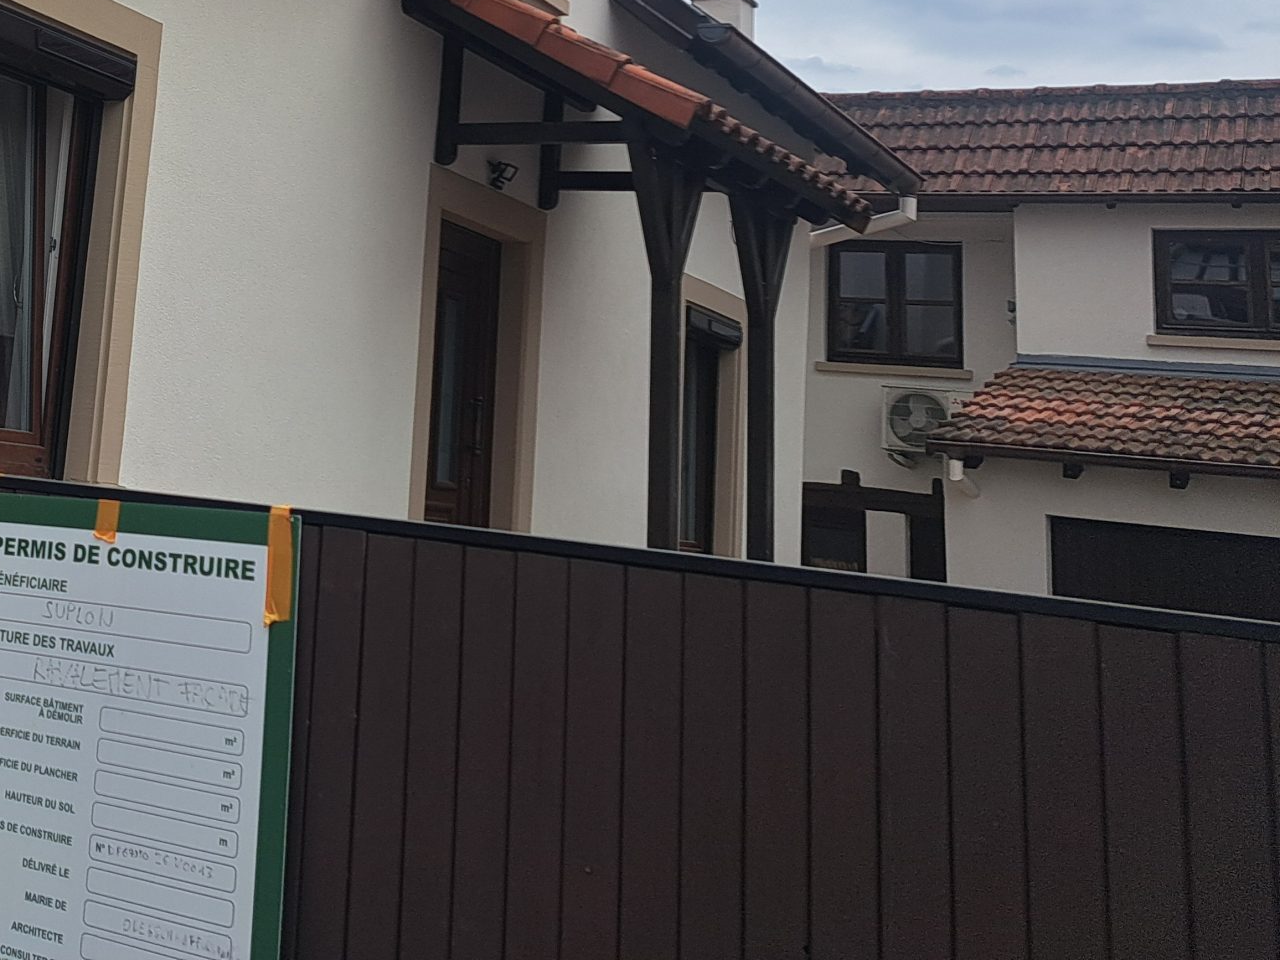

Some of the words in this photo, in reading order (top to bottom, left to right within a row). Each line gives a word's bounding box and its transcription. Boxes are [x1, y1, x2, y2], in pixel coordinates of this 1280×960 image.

[73, 543, 100, 565] DE
[107, 547, 256, 581] CONSTRUIRE
[33, 634, 56, 649] DES
[60, 637, 115, 658] TRAVAUX
[5, 692, 41, 707] SURFACE
[43, 697, 84, 714] BÂTIMENT
[38, 707, 45, 718] À
[46, 709, 83, 724] DÉMOLIR
[32, 733, 44, 743] DU
[46, 735, 81, 751] TERRAIN
[21, 762, 32, 773] DU
[34, 764, 78, 782] PLANCHER
[5, 789, 44, 807] HAUTEUR
[45, 798, 57, 810] DU
[59, 801, 75, 814] SOL
[7, 822, 19, 833] DE
[20, 824, 72, 846] CONSTRUIRE
[219, 837, 228, 847] m
[95, 842, 106, 853] N°
[22, 858, 57, 876] DÉLIVRÉ
[59, 867, 71, 879] LE
[25, 891, 53, 908] MAIRIE
[55, 899, 67, 911] DE
[11, 921, 63, 945] ARCHITECTE
